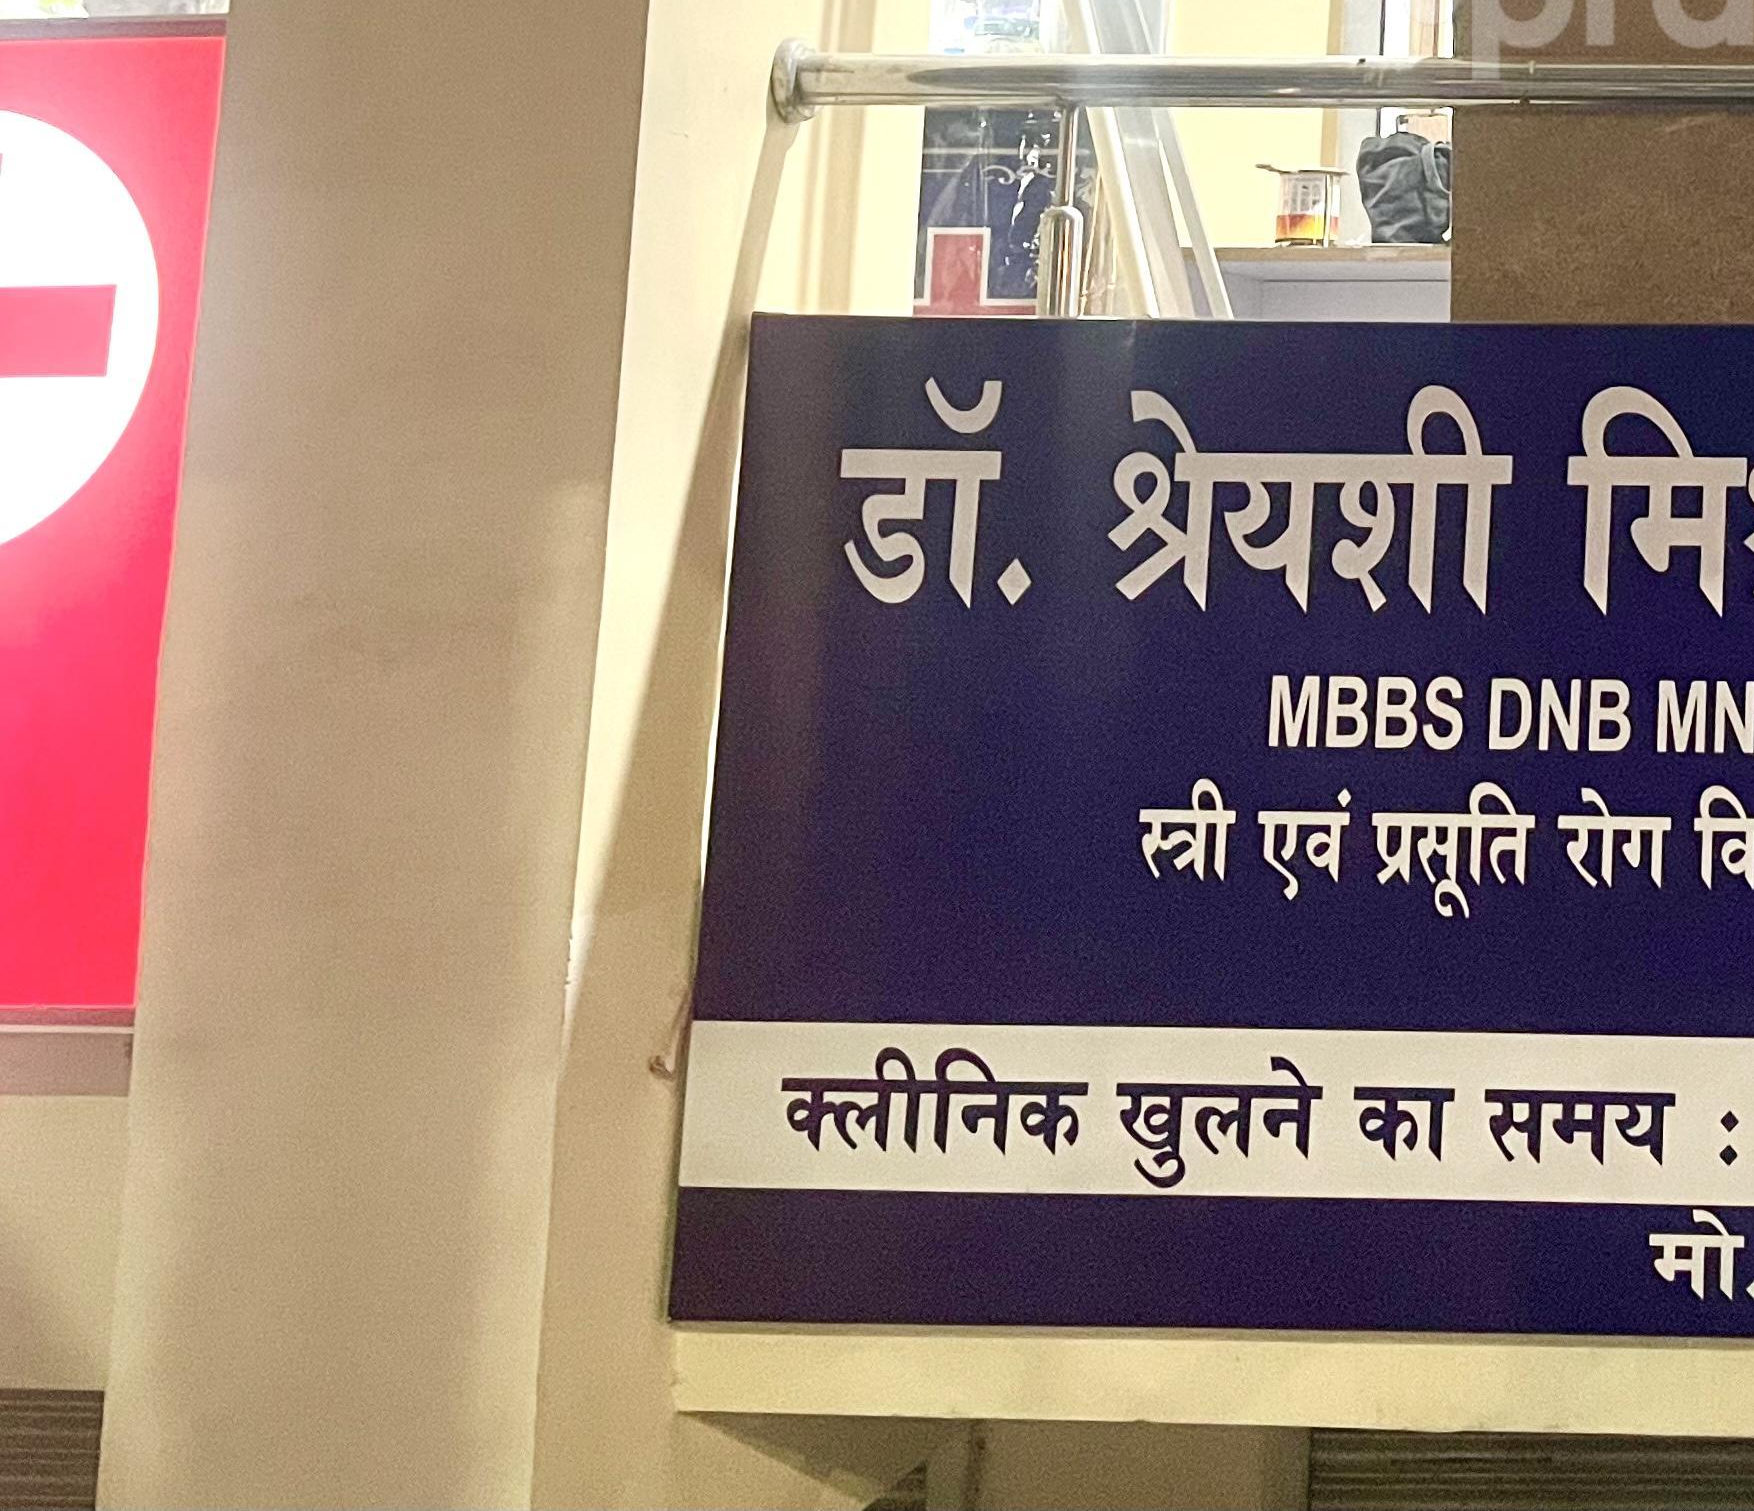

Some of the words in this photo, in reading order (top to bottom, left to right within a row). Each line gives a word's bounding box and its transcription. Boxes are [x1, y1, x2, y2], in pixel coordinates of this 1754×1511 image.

[840, 377, 1031, 608] डॉ.
[1108, 385, 1513, 614] श्रेयशी
[1269, 675, 1463, 750] MBBS
[1489, 678, 1631, 751] DNB
[1139, 779, 1236, 881] स्त्री
[1258, 789, 1351, 900] एवं
[1372, 782, 1535, 918] प्रसूति
[1558, 788, 1671, 888] रोग
[781, 1047, 1089, 1155] क्लीनिक
[1116, 1057, 1323, 1188] खुलने
[1354, 1087, 1455, 1161] का
[1485, 1089, 1676, 1165] समय
